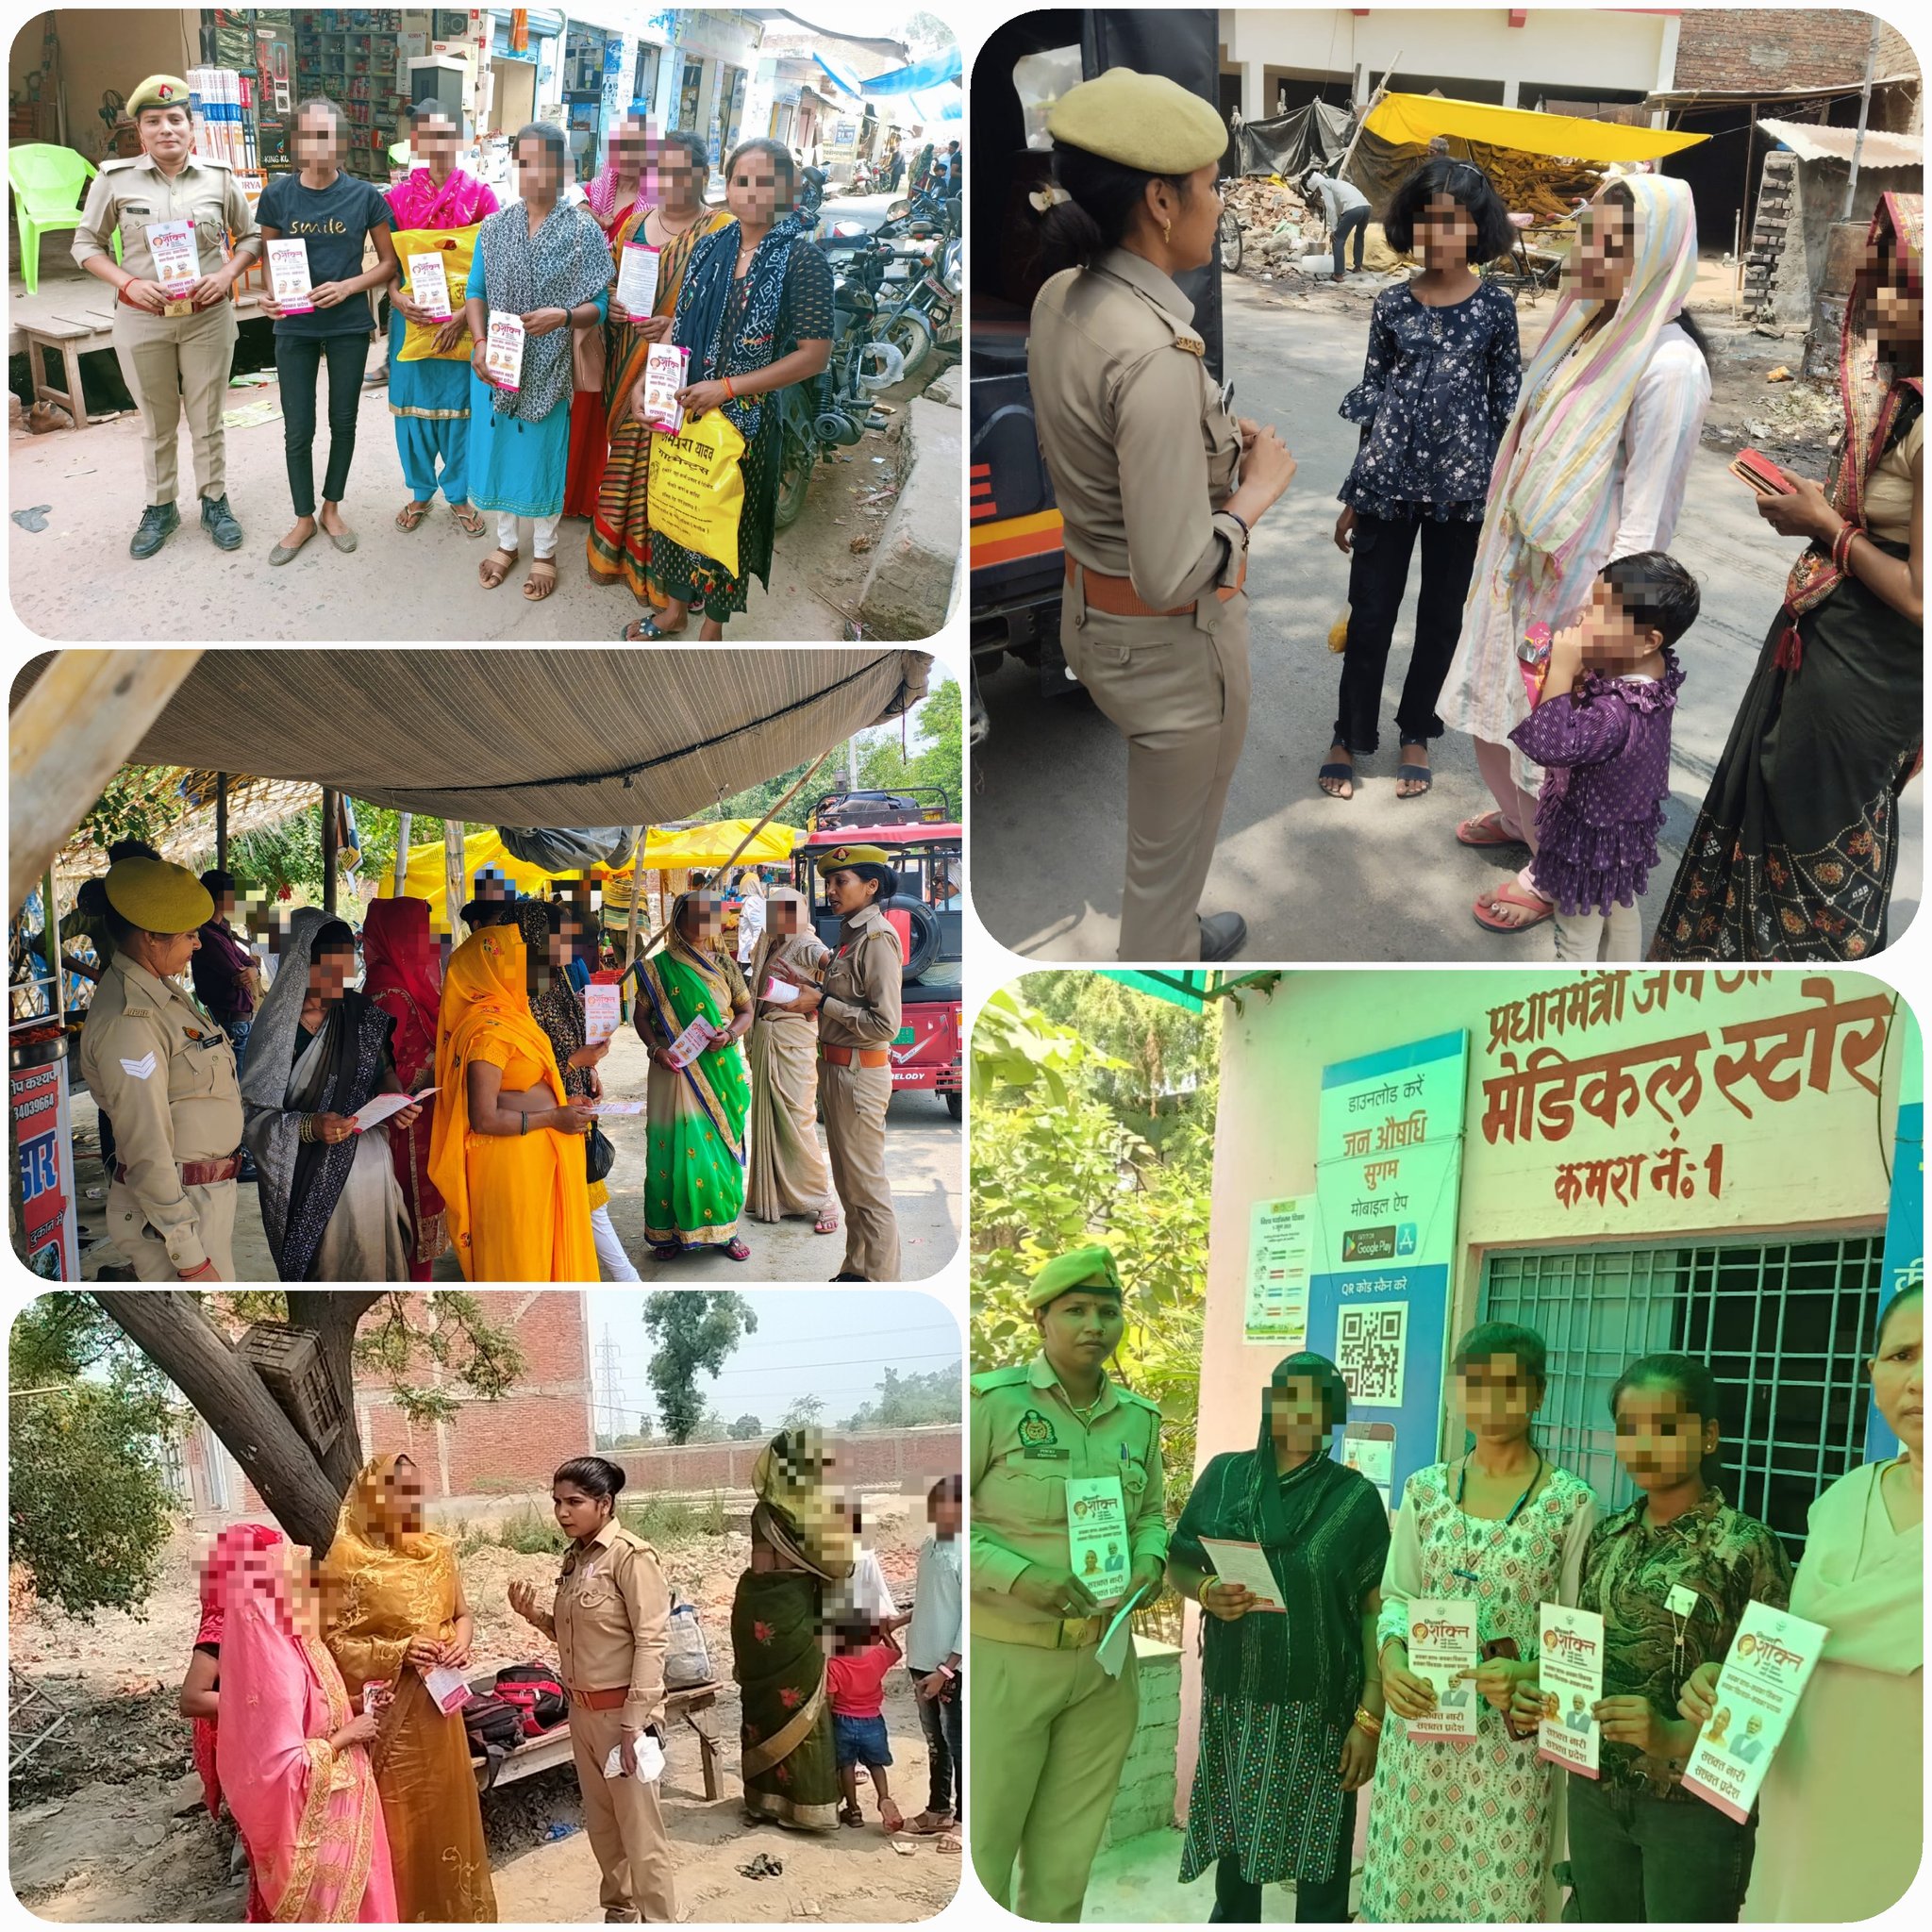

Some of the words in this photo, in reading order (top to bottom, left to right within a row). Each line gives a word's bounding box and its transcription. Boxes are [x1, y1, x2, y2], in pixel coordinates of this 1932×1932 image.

[290, 216, 346, 234] smile
[694, 441, 715, 461] यादव
[1482, 1031, 1711, 1145] मेडिकल
[1713, 977, 1897, 1120] स्टोर
[25, 1071, 57, 1090] कश्यप
[1348, 1082, 1398, 1112] डाउनलोड
[1403, 1074, 1425, 1098] करें
[1343, 1128, 1373, 1157] जन
[1375, 1109, 1427, 1151] औषधि
[1364, 1159, 1399, 1191] सुगम
[1554, 1153, 1649, 1210] कमरा
[1351, 1197, 1390, 1218] मोबाइल
[1393, 1191, 1408, 1213] ऐप
[30, 1219, 54, 1248] दुकान
[1357, 1241, 1378, 1256] Google
[1379, 1240, 1391, 1254] Play
[1341, 1283, 1355, 1296] QR
[1356, 1278, 1373, 1293] कोड
[1088, 1494, 1118, 1518] शक्ति
[1429, 1619, 1470, 1645] शक्ति
[1557, 1629, 1596, 1657] शक्ति
[1755, 1638, 1804, 1673] शक्ति
[1568, 1748, 1587, 1762] प्रदेश
[1569, 1736, 1587, 1749] नारी
[1701, 1751, 1725, 1771] सशक्त
[1725, 1761, 1746, 1783] नारी
[1694, 1765, 1719, 1787] सशक्त
[1720, 1778, 1741, 1800] प्रदेश
